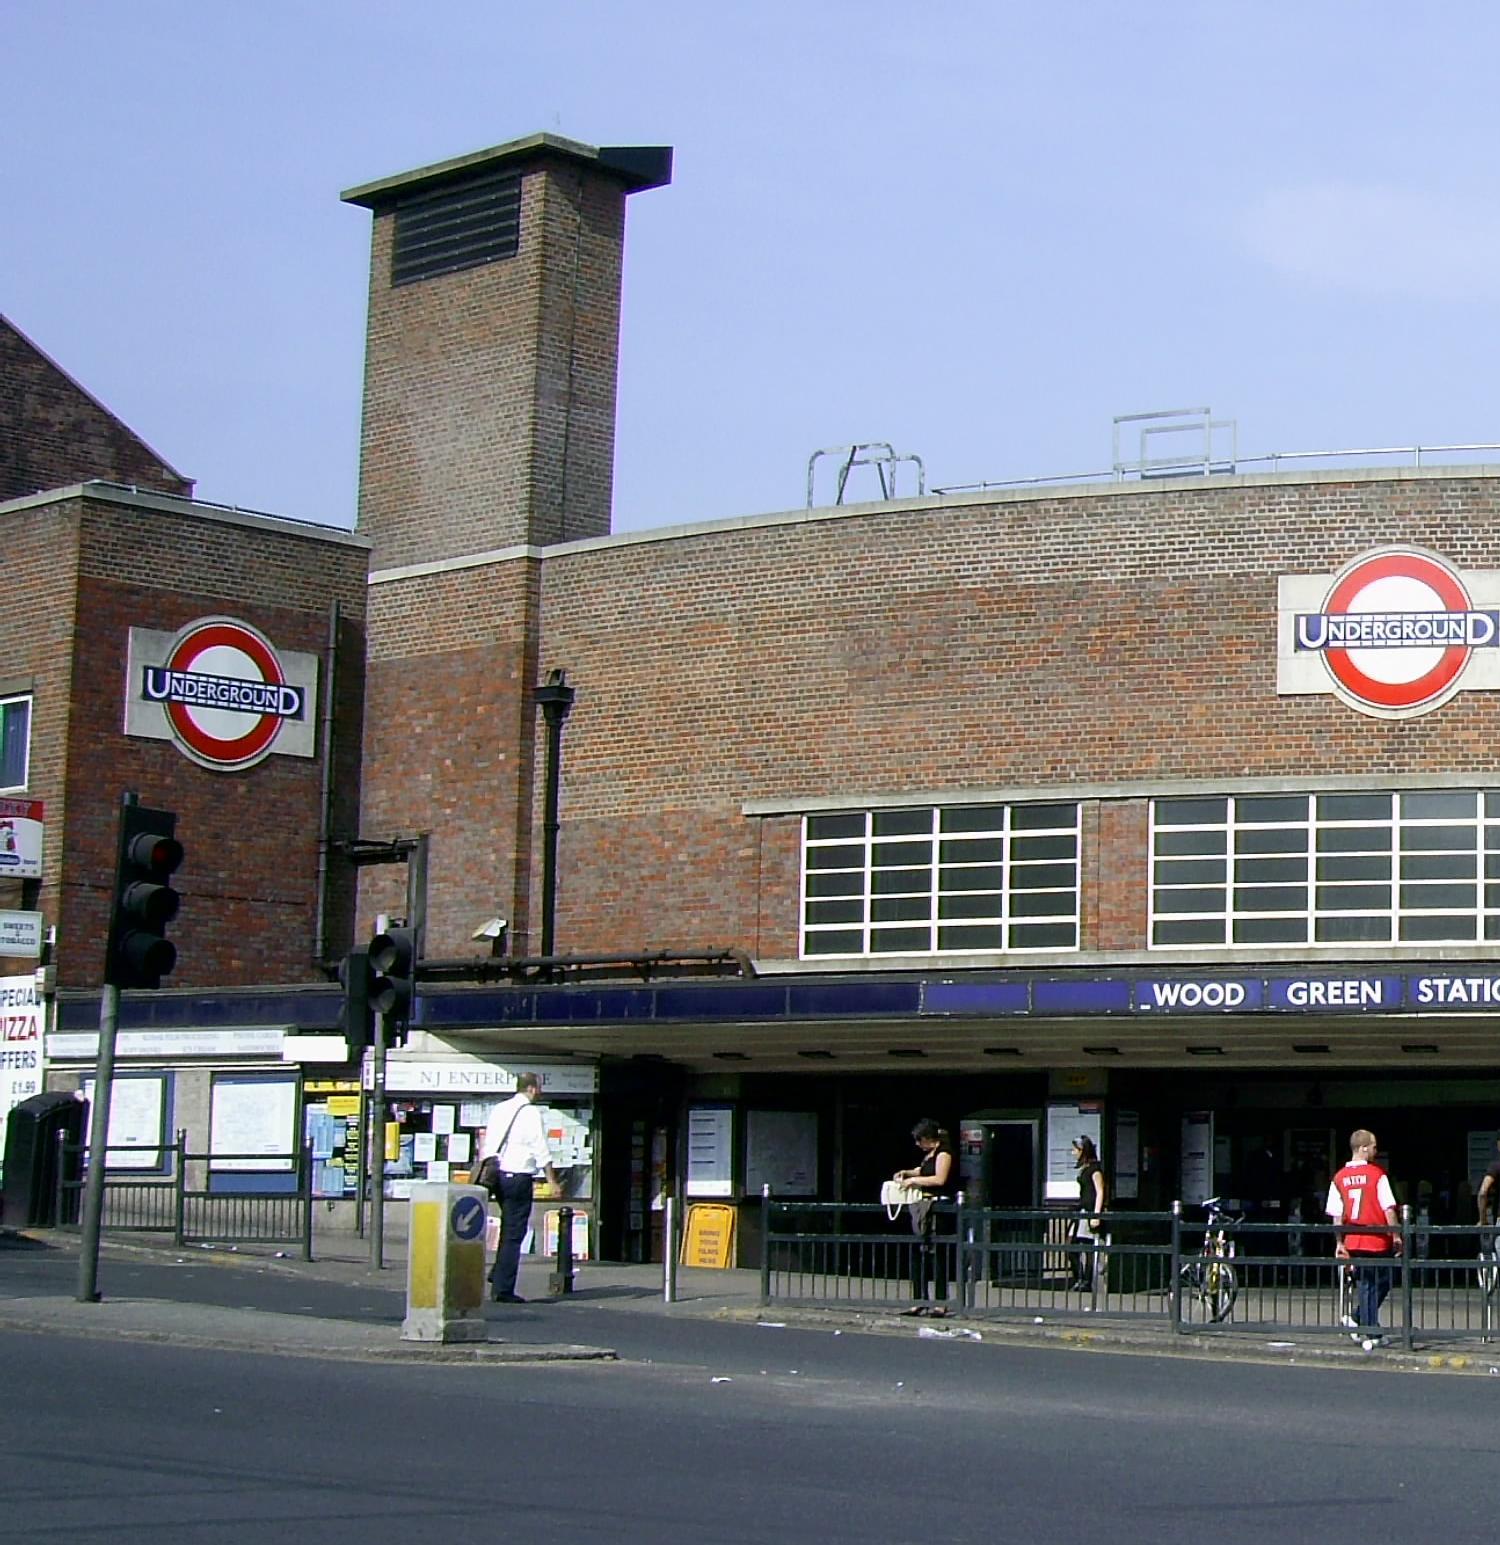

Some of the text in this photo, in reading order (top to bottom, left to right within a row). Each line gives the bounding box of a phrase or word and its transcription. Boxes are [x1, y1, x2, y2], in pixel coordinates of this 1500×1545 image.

[1299, 612, 1495, 648] UNDERGROUND
[148, 669, 300, 715] UNDERGROUND
[1153, 983, 1246, 1006] WOOD
[1286, 980, 1382, 1005] GREEN
[0, 1016, 37, 1040] IZZA
[0, 1050, 36, 1069] FFERS
[450, 1071, 552, 1086] ENTERPE
[1348, 1188, 1362, 1220] 7
